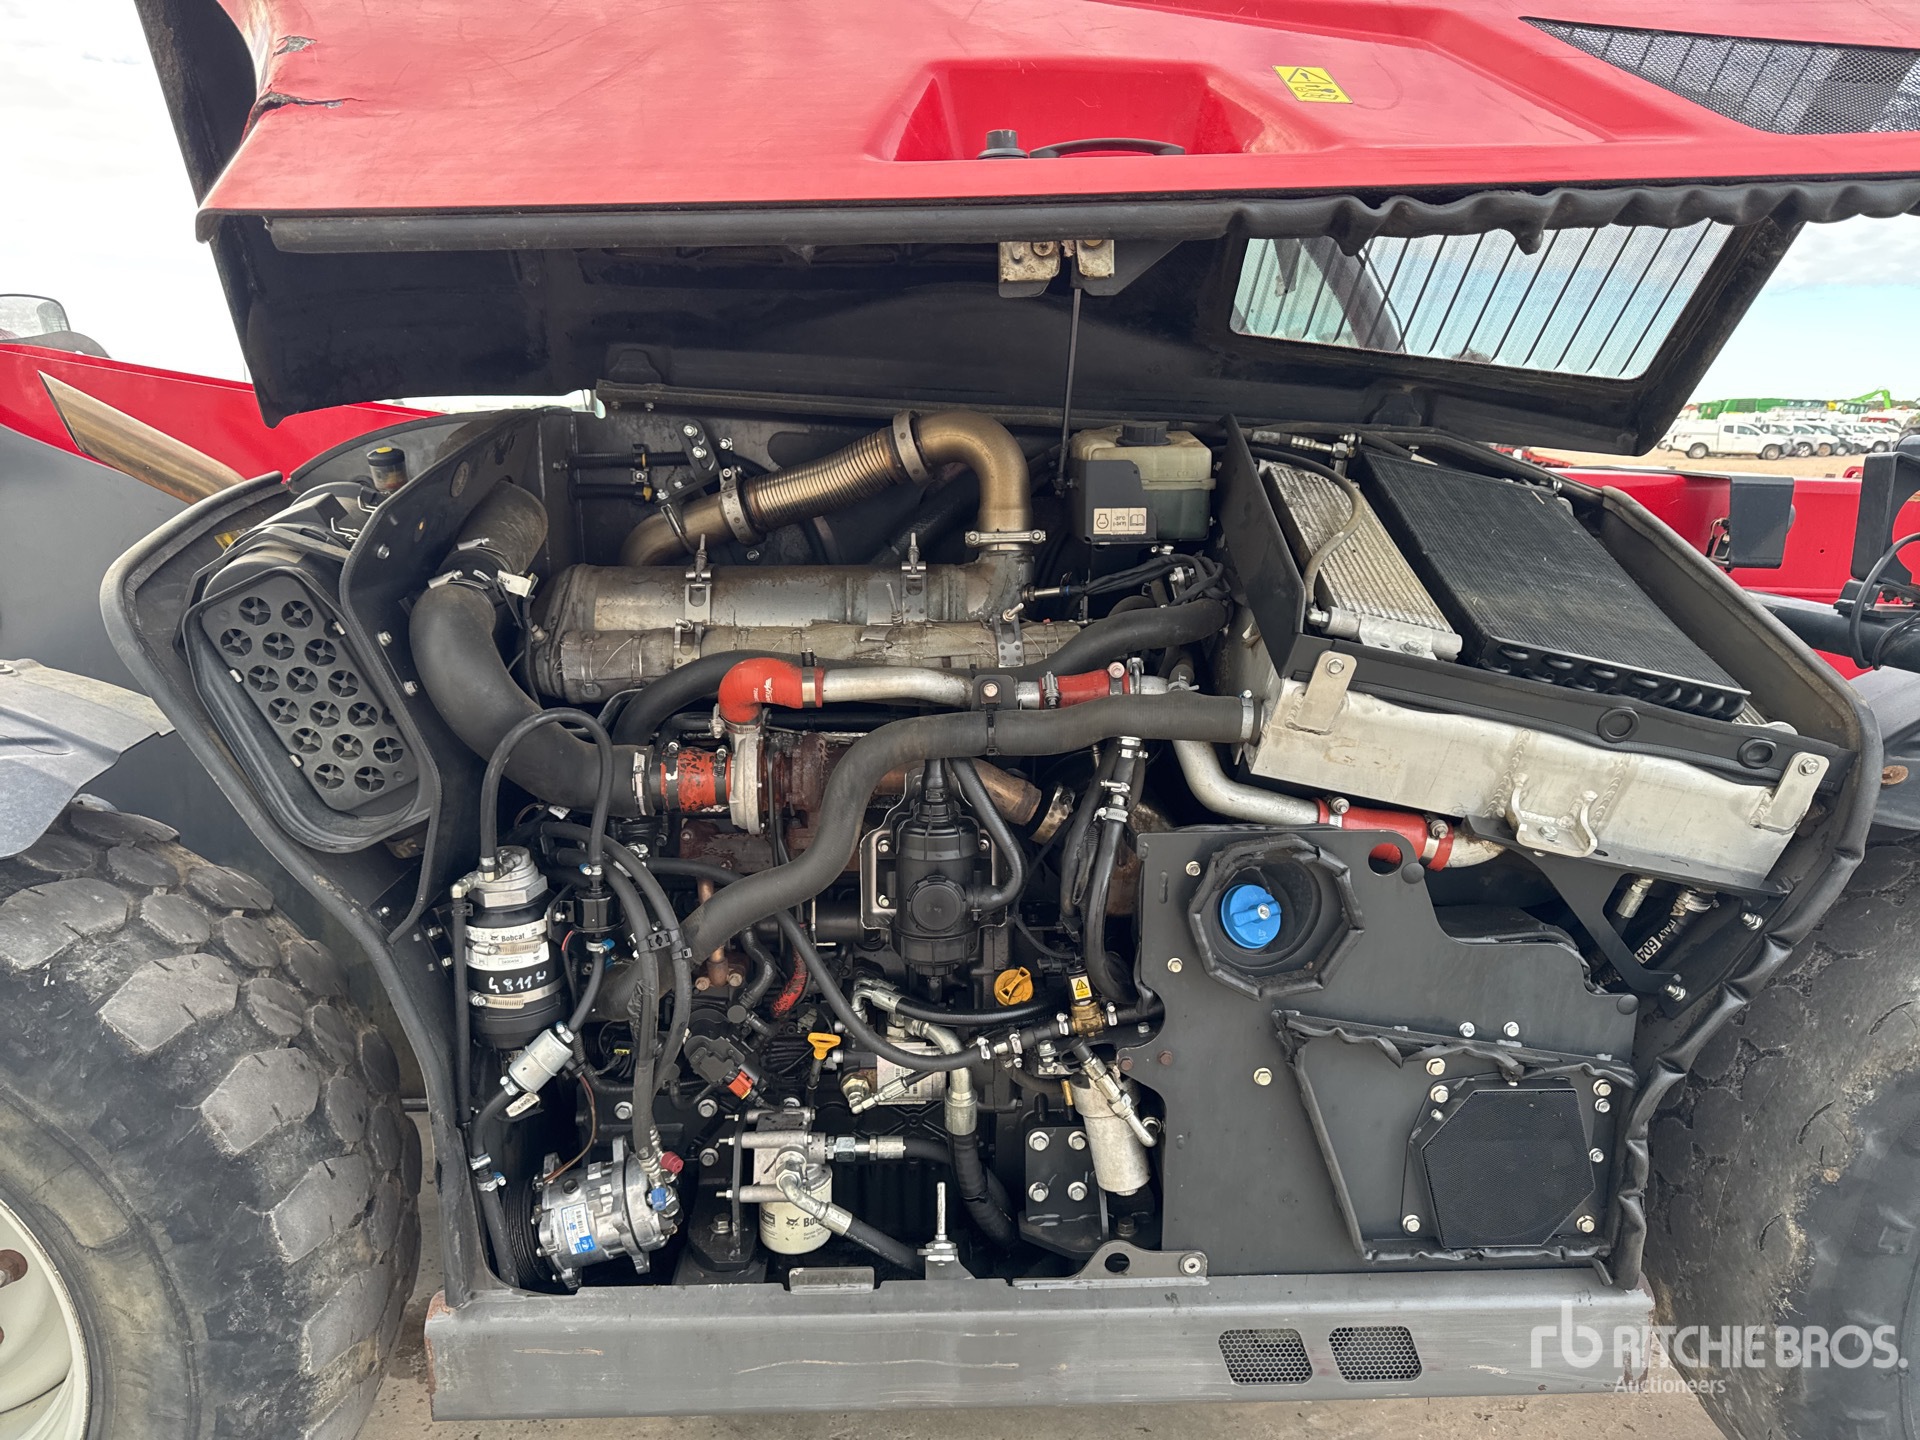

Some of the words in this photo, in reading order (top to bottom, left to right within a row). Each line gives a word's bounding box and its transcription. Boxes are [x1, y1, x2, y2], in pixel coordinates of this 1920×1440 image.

[501, 933, 525, 942] Bobcat
[1658, 919, 1677, 941] ITALY
[1636, 939, 1659, 962] 604
